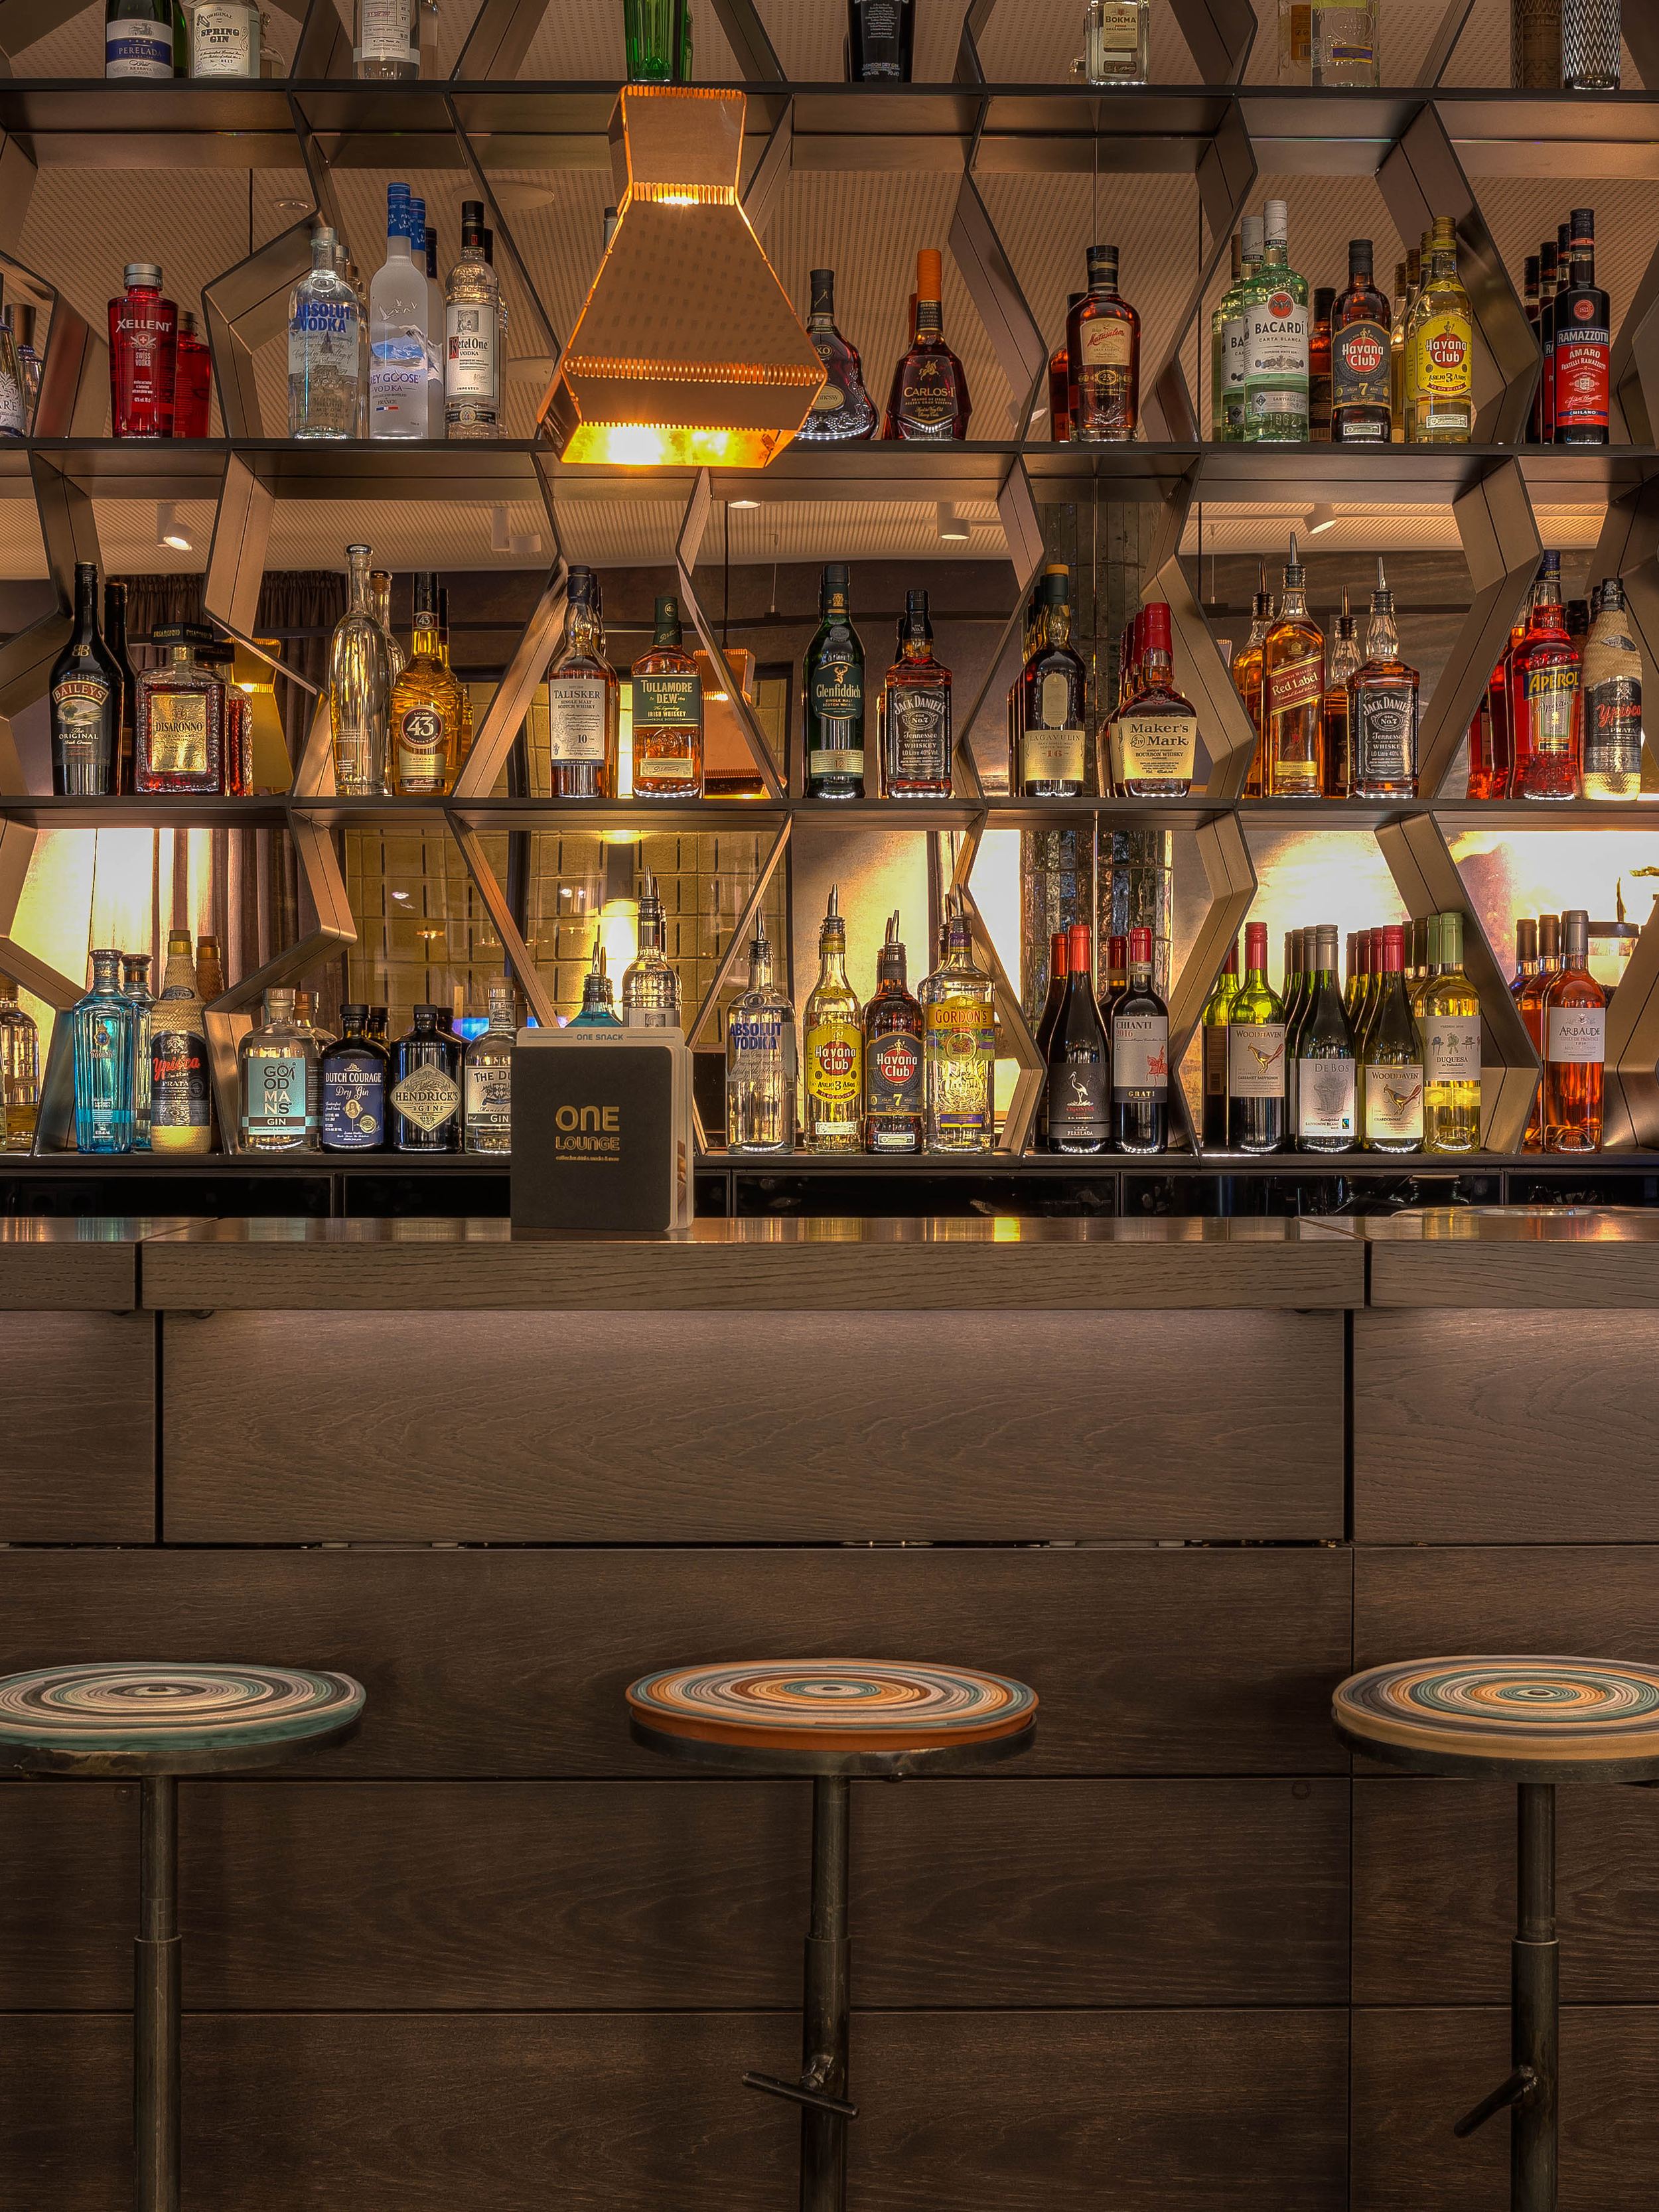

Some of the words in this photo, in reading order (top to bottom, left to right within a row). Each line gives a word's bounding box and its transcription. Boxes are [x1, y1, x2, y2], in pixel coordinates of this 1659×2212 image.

[201, 27, 240, 37] SPRING
[119, 46, 163, 58] PERELADA
[296, 303, 351, 320] ABSOLUT
[115, 318, 171, 333] XELLENT
[299, 317, 346, 333] VODKA
[1558, 330, 1609, 344] RAMAZZOTTI
[1342, 342, 1384, 356] Havana
[1425, 338, 1467, 352] Havana
[135, 350, 151, 360] SWISS
[1350, 354, 1376, 366] Club
[1434, 350, 1460, 363] Club
[1569, 348, 1601, 359] AMARO
[1561, 360, 1580, 371] FRATELLI
[1580, 358, 1606, 370] RAMAZZOTTI
[383, 371, 419, 384] GOOSE
[1445, 373, 1453, 383] 3
[904, 387, 948, 397] CARLOS
[1358, 383, 1368, 395] 7
[418, 616, 431, 625] 43
[640, 679, 693, 693] TULLAMORE
[1528, 671, 1579, 693] APEROL
[54, 685, 104, 699] BAILEYS
[553, 689, 601, 699] TALISKER
[816, 683, 861, 698] Glenfiddich
[1272, 683, 1292, 695] Red
[893, 699, 914, 715] JACK
[914, 695, 946, 715] DANIEL'S
[1362, 699, 1383, 716] JACK
[156, 722, 204, 732] DISARONNO
[406, 716, 435, 736] 43
[1129, 723, 1189, 733] Maker's
[577, 734, 588, 744] 10
[1146, 736, 1189, 746] Mark
[835, 760, 844, 768] 12
[935, 1009, 987, 1024] GORDON'S
[730, 1022, 782, 1036] ABSOLUT
[1559, 1026, 1601, 1036] ARBAUDE
[733, 1036, 777, 1050] VODKA
[815, 1045, 857, 1058] Havana
[824, 1058, 849, 1070] Club
[876, 1052, 918, 1065] Havana
[325, 1072, 348, 1083] DUTCH
[348, 1072, 382, 1083] COURAGE
[474, 1071, 494, 1083] THE
[885, 1065, 910, 1077] Club
[834, 1080, 841, 1091] 3
[335, 1086, 352, 1100] Dry
[353, 1085, 369, 1100] Gin
[396, 1091, 459, 1101] HENDRICK'S
[893, 1093, 902, 1107] 7
[490, 1114, 509, 1123] GIN
[555, 1105, 620, 1132] ONE
[555, 1136, 620, 1151] LOUNGE
